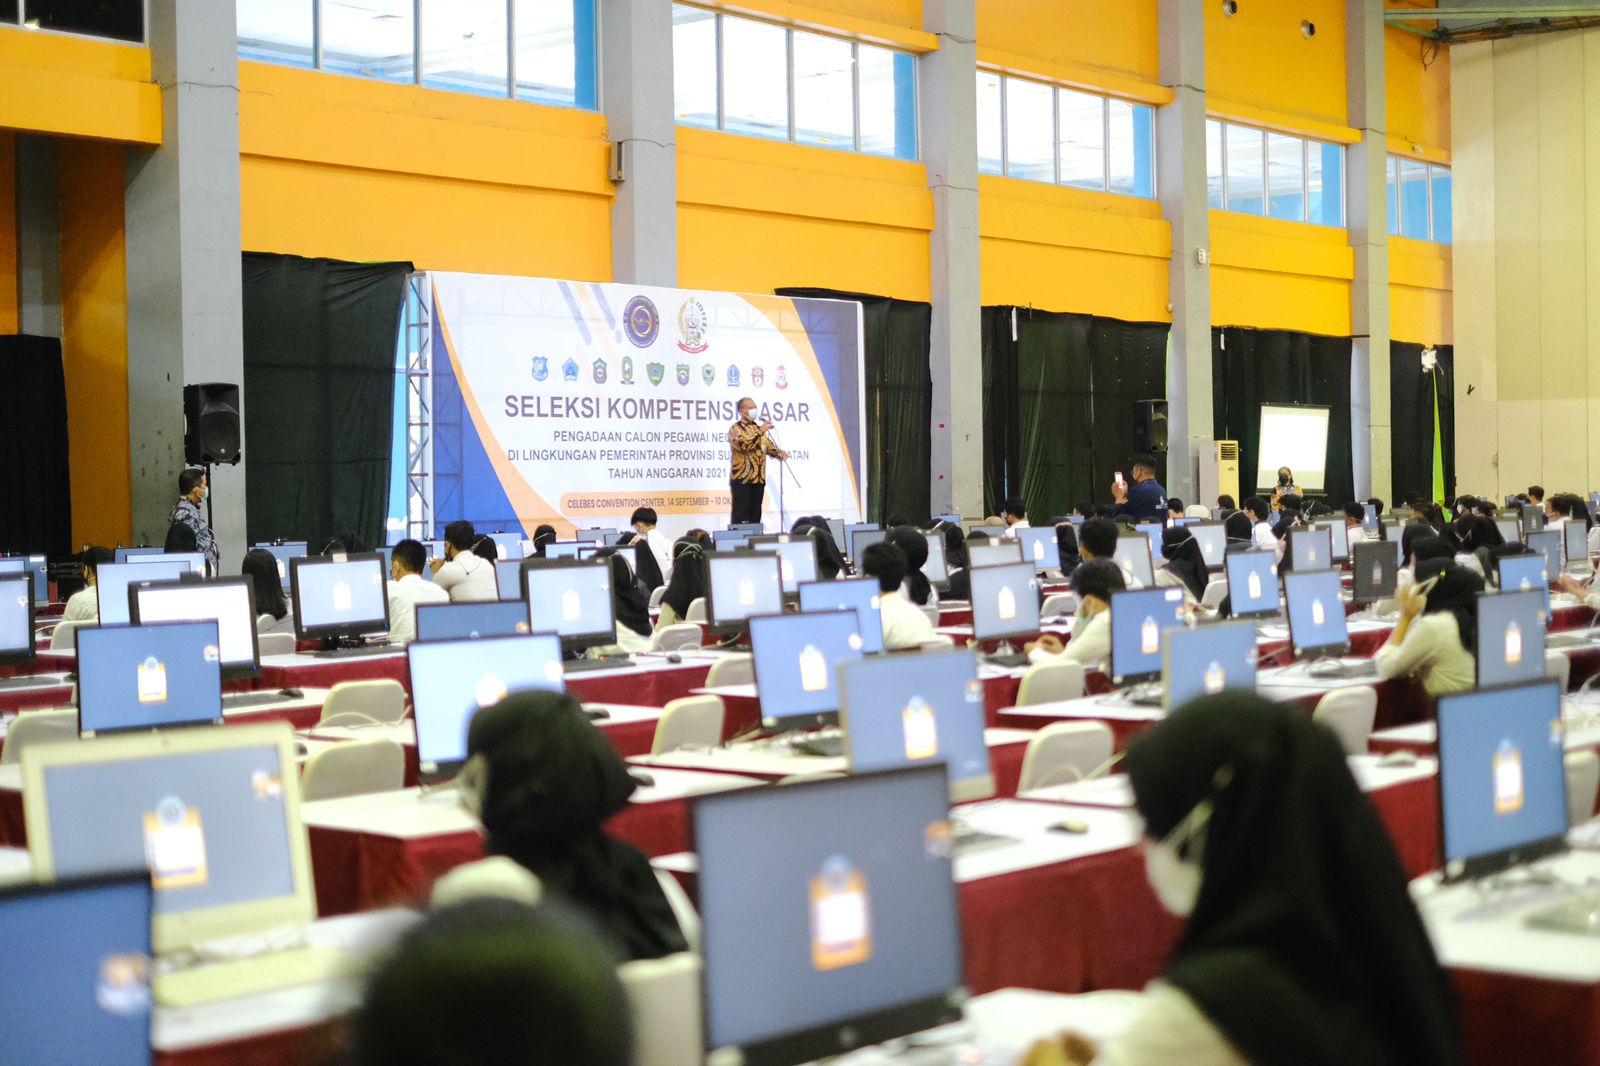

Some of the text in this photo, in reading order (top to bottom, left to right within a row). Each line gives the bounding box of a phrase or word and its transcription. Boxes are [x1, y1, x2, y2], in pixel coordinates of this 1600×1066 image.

[504, 395, 810, 422] SELEKSI KOMPETENSI ASAR
[553, 430, 623, 442] PENGADAAN
[625, 431, 661, 443] CALON
[664, 432, 709, 443] PEGAWAI
[508, 449, 519, 461] DI
[522, 449, 597, 461] LINGKUNGAN
[600, 449, 666, 461] PEMERINTAH
[669, 449, 716, 461] PROVINSI
[608, 467, 726, 479] TAHUN ANGGARAN 2021
[567, 499, 595, 509] CELEBES
[596, 498, 640, 508] CONVENTION
[667, 497, 675, 506] 14
[675, 496, 709, 507] SEPTEMBER
[715, 496, 722, 506] 10
